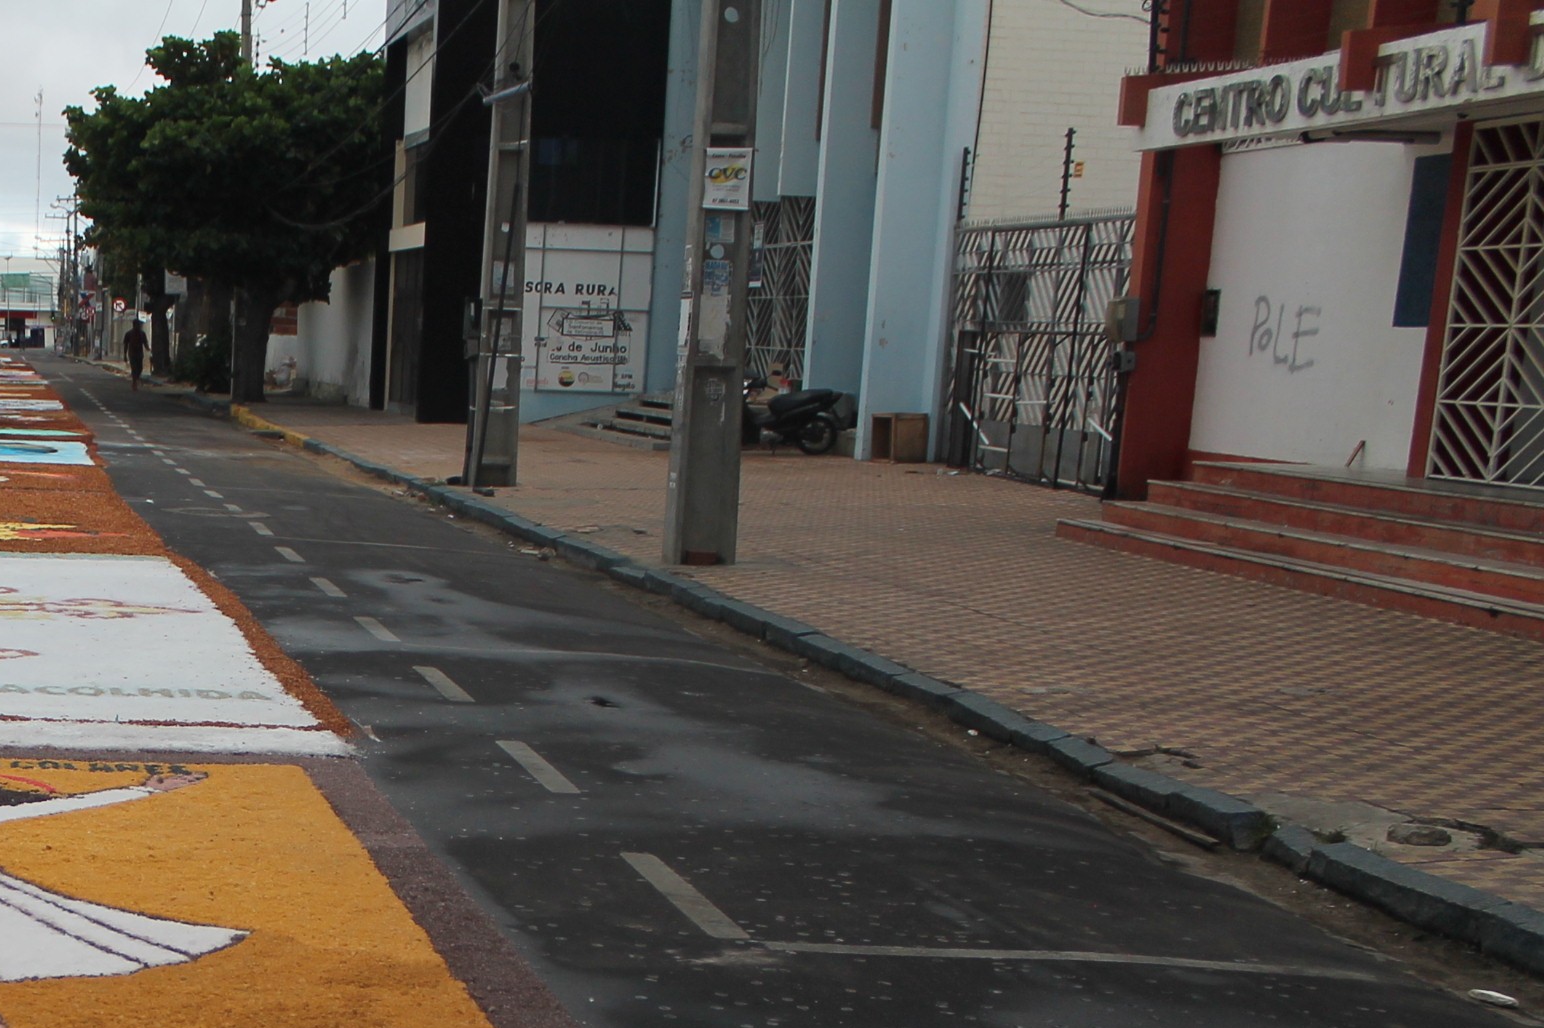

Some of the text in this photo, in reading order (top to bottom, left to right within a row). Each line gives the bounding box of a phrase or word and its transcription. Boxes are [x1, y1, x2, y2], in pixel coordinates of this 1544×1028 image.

[1172, 74, 1291, 137] CENTRO
[708, 167, 748, 180] CVC
[568, 341, 583, 352] de
[590, 342, 627, 354] Junho
